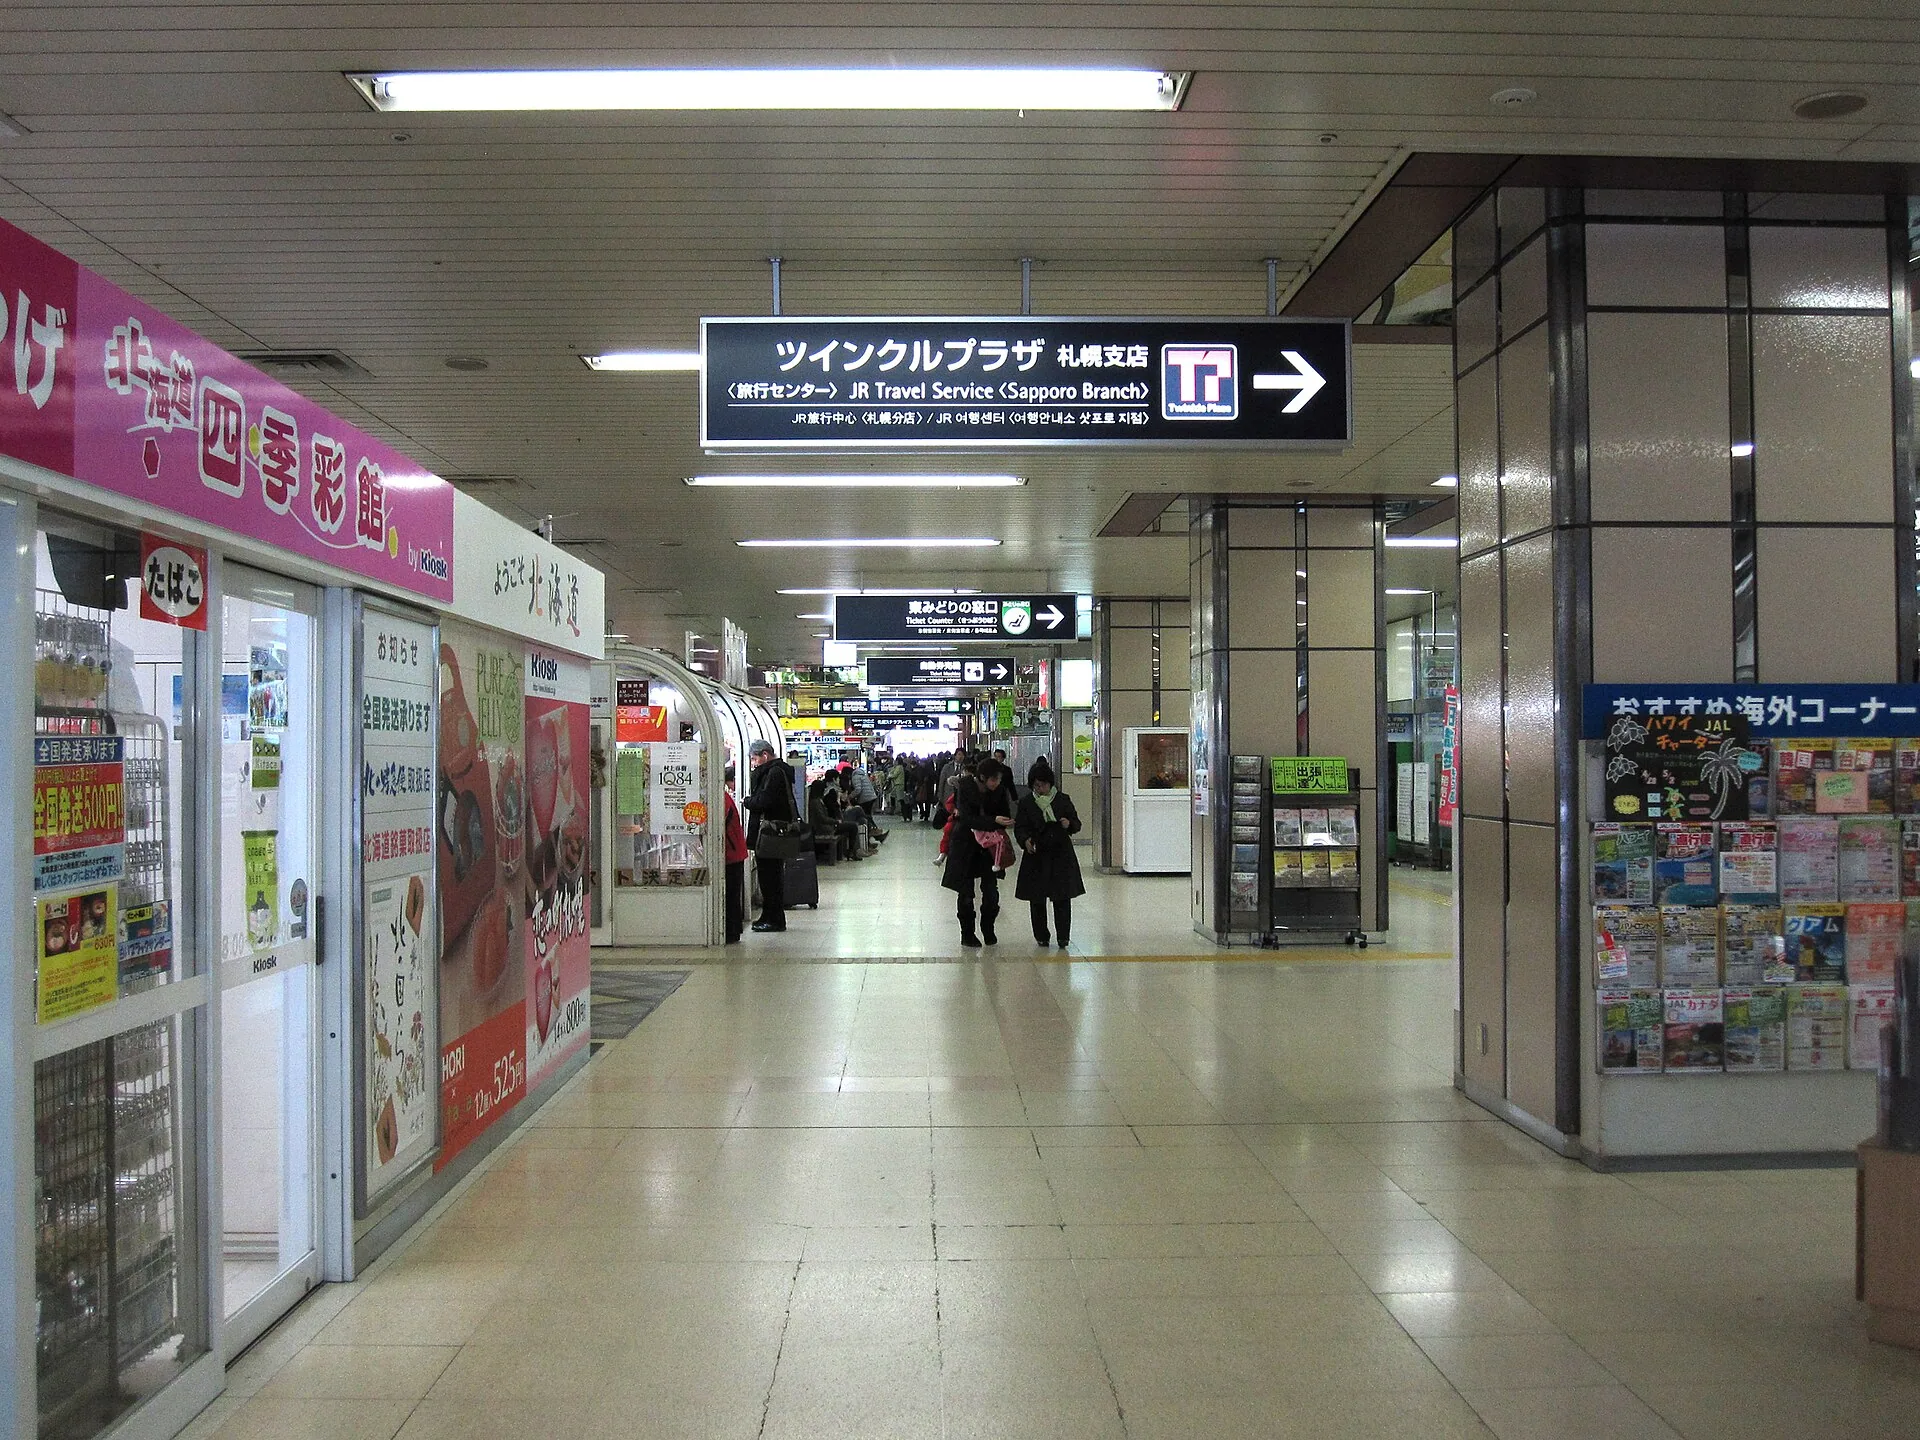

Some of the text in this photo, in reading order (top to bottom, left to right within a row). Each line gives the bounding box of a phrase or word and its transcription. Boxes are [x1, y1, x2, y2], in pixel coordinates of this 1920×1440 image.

[0, 288, 67, 410] げ
[776, 337, 1148, 372] ツインクルプラザ 札幌支店
[849, 382, 870, 399] JR
[875, 382, 926, 399] Travel
[932, 382, 994, 399] Service
[792, 412, 857, 424] JR旅行中心
[936, 413, 953, 424] JR
[955, 412, 1005, 424] 여행센터
[1079, 412, 1116, 424] 삿포로
[408, 541, 448, 580] by Kiosk
[148, 556, 200, 605] たばこ
[494, 553, 580, 637] ようこそ 北海道
[906, 616, 927, 624] Ticket
[928, 616, 954, 625] Counter
[908, 600, 998, 614] 東みどりの窓口
[378, 631, 419, 667] お知らせ
[530, 652, 558, 681] Kiosk
[363, 693, 431, 734] 全国発送承ります
[1611, 695, 1918, 726] おすすめ海外コーナー
[1645, 715, 1731, 732] ハワイ JAL
[38, 740, 118, 763] 全国発送承ります
[1656, 734, 1722, 751] チャーター
[659, 772, 692, 787] 1Q84
[253, 955, 277, 973] Kiosk
[442, 1044, 465, 1083] HORI
